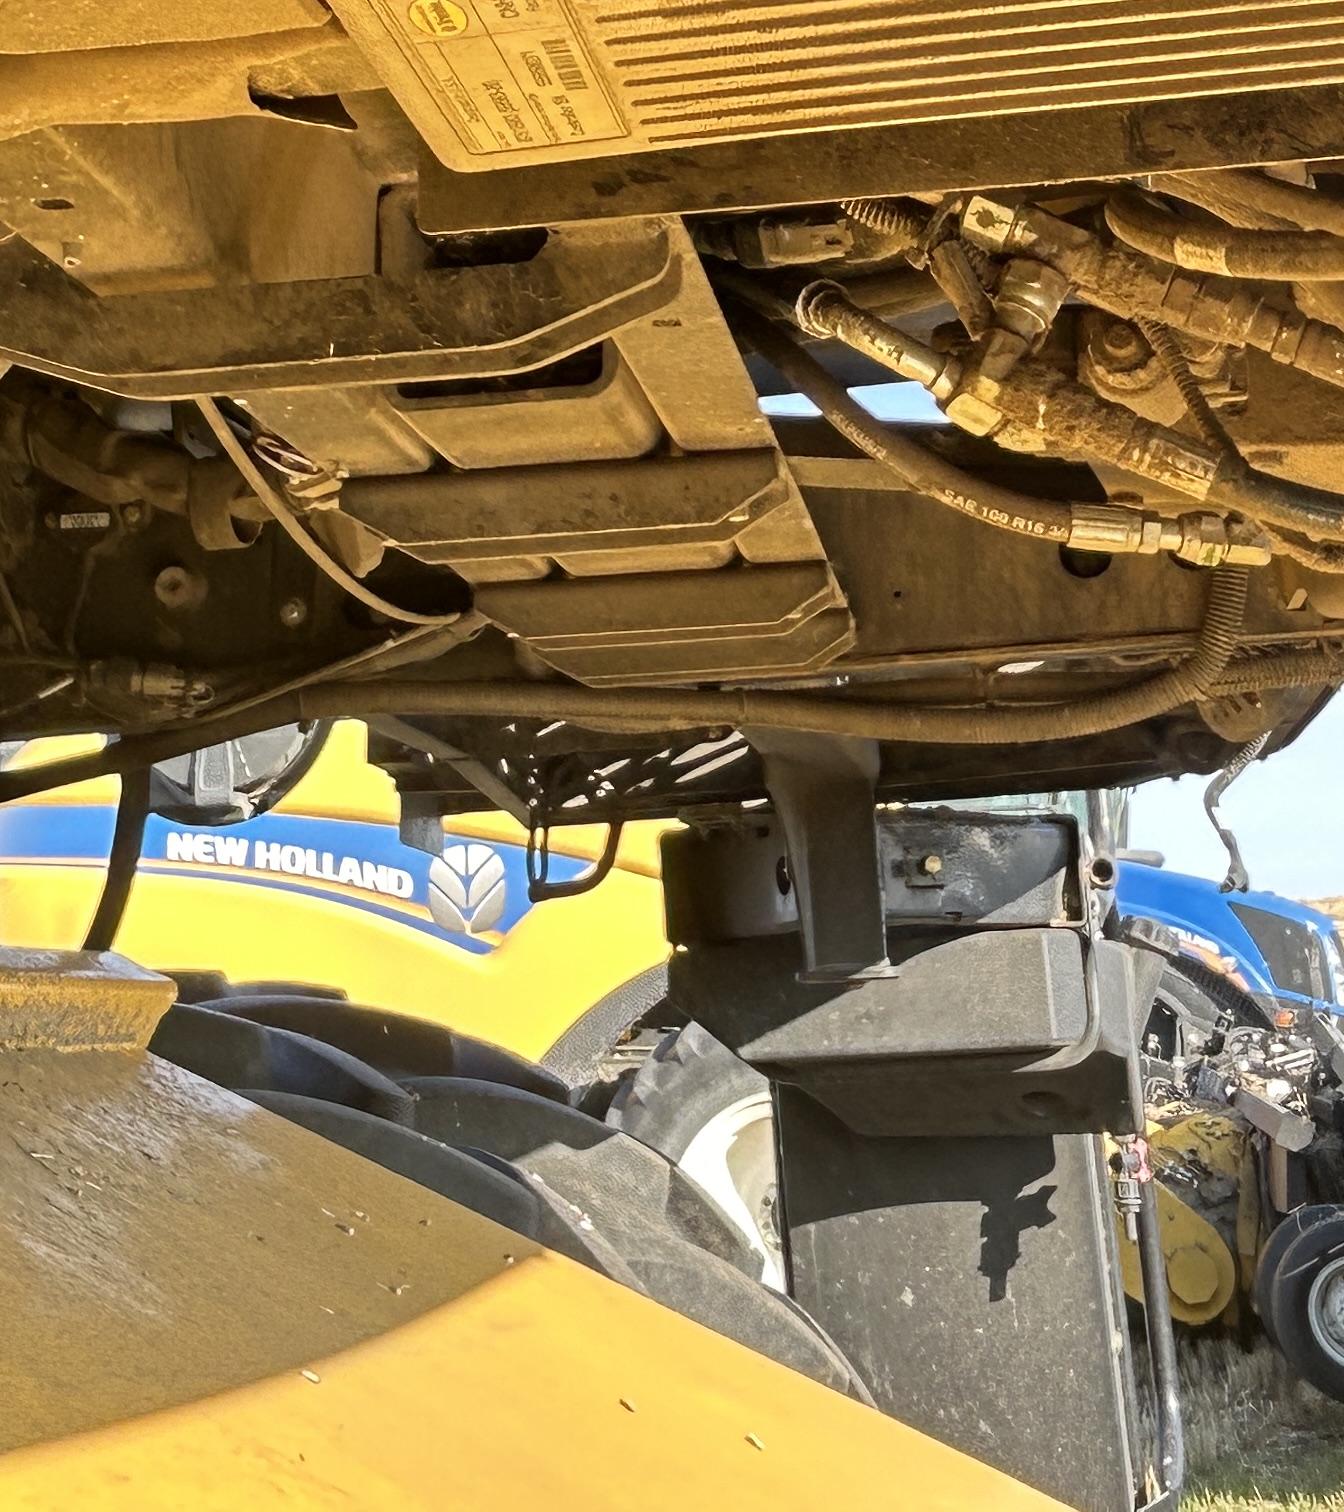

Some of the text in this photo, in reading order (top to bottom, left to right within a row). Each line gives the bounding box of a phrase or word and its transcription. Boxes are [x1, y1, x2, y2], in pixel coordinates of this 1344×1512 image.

[944, 489, 977, 512] SAE
[1012, 516, 1044, 534] R16
[166, 831, 415, 899] NEW HOLLAND
